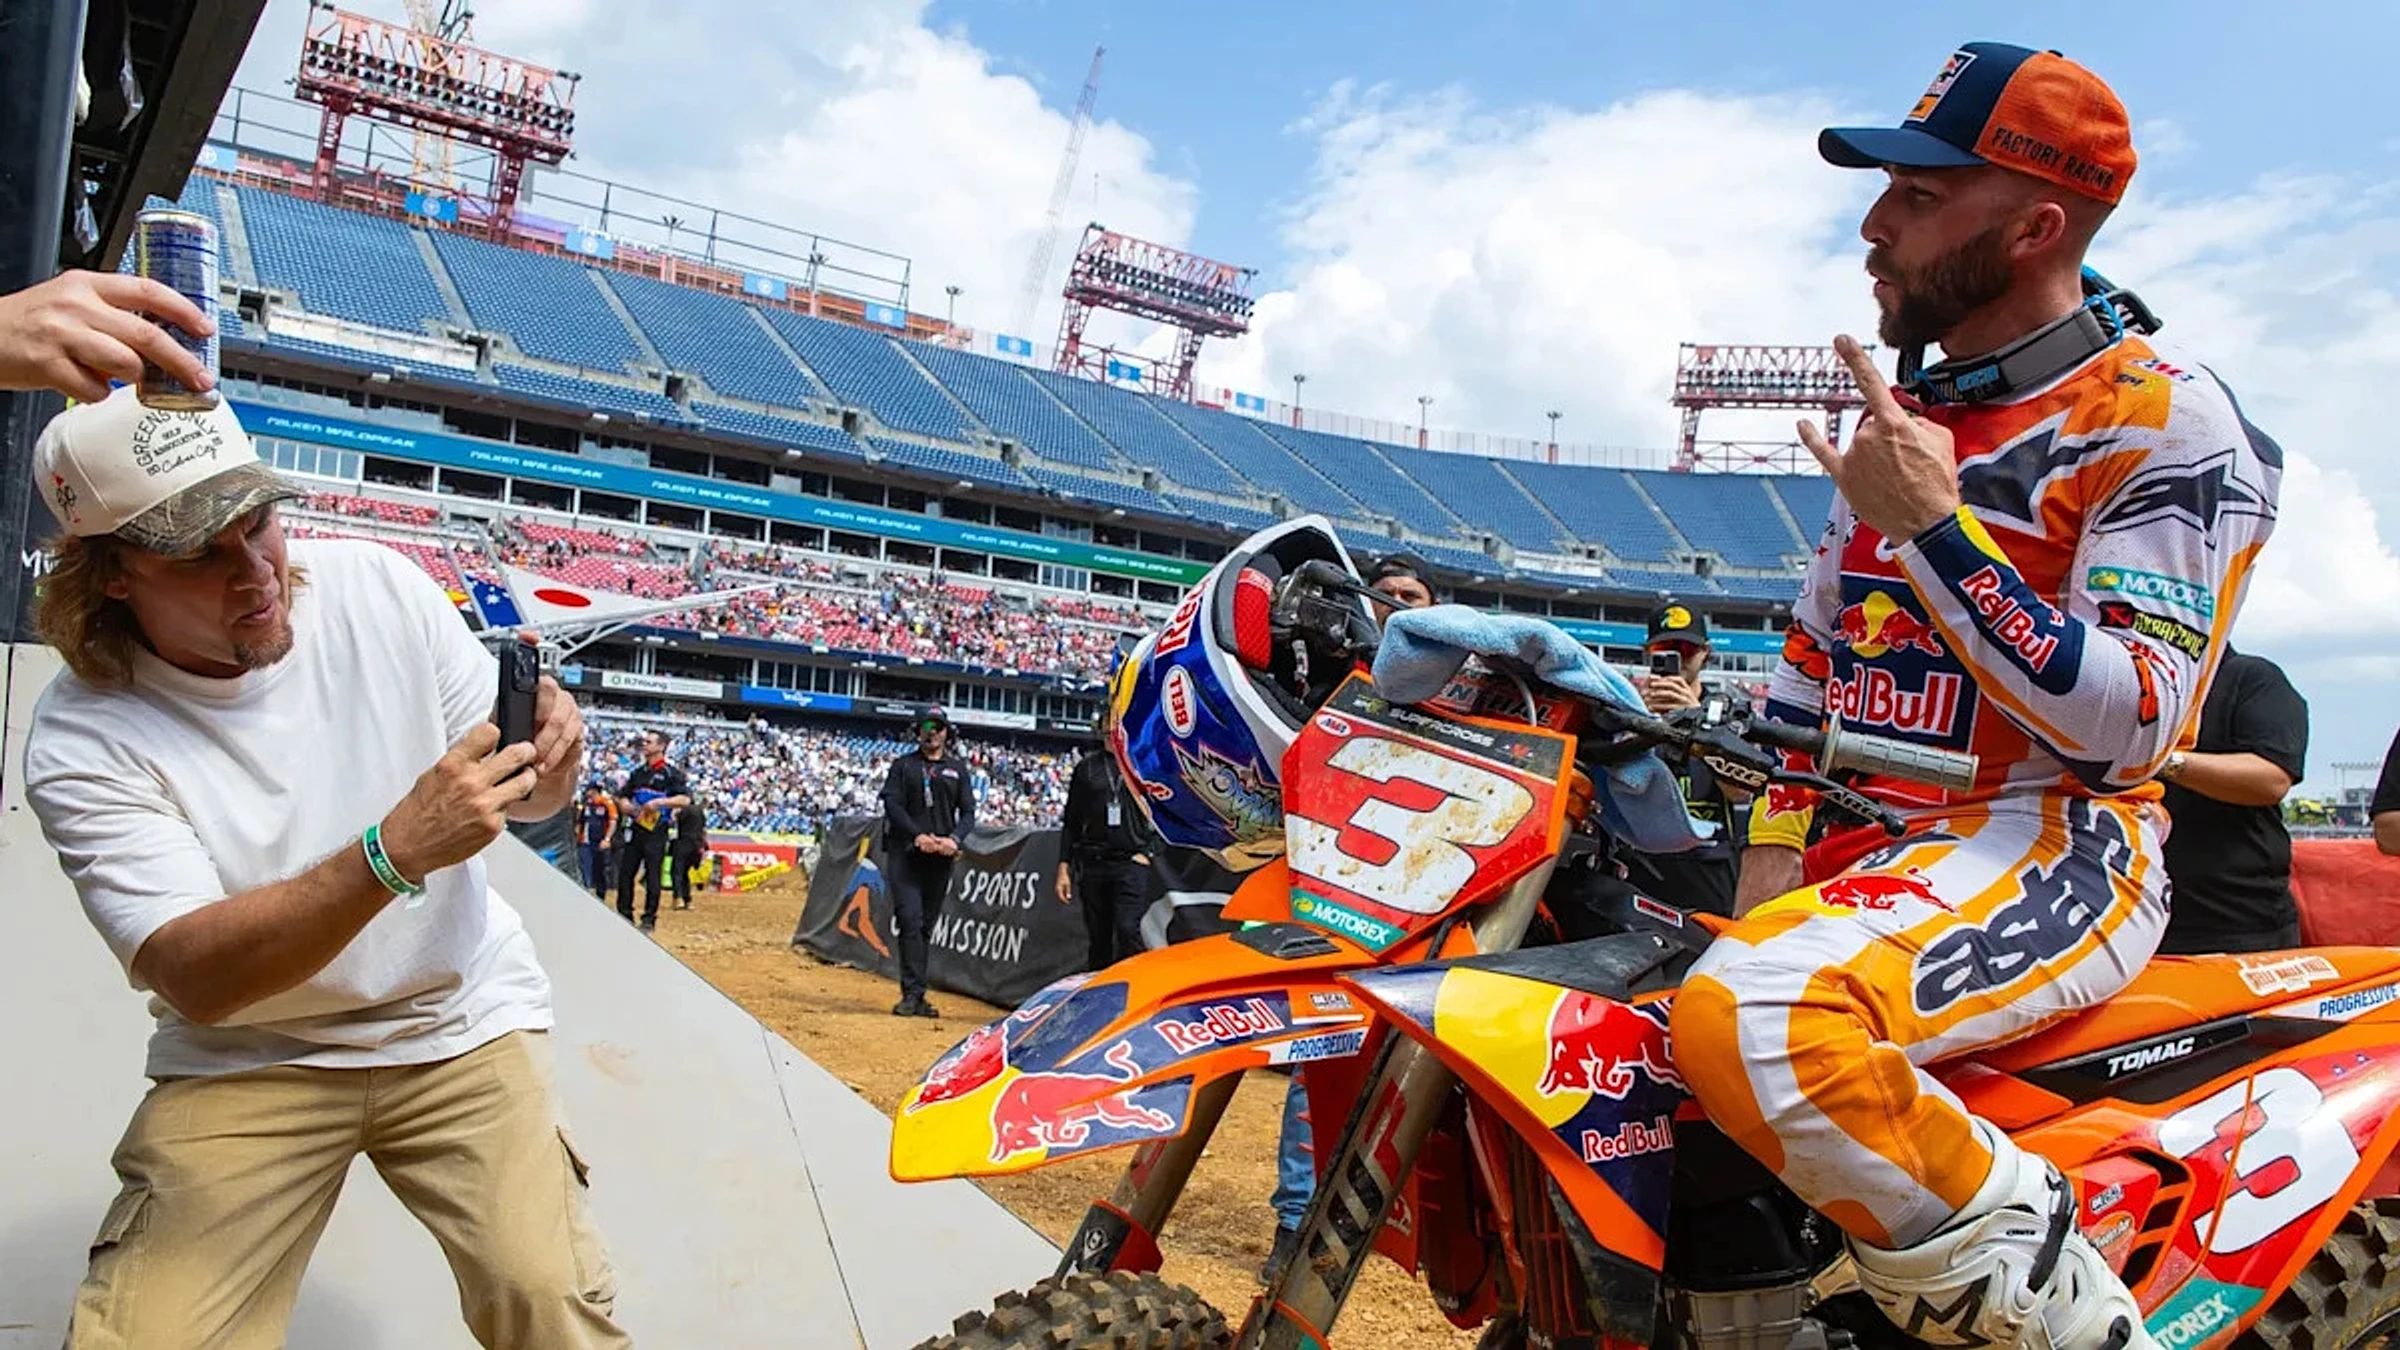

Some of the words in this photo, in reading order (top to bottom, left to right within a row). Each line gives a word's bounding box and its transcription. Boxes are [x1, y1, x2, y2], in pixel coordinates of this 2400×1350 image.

[1990, 126, 2062, 168] FACTORY
[2064, 153, 2115, 191] RACING
[132, 408, 171, 467] GREENS
[2120, 571, 2212, 614] MOTORE
[1169, 673, 1190, 728] BELL
[1827, 664, 1864, 722] ed
[1864, 669, 1962, 737] Bull
[1389, 706, 1496, 748] SUPERCROSS
[1283, 736, 1535, 916] 3
[706, 850, 778, 866] NDA
[958, 867, 1040, 910] SPORTS
[1312, 902, 1392, 945] MOTOREX
[2318, 984, 2399, 1018] PROGRESSIVE
[2106, 1036, 2196, 1078] TOMAC
[1582, 1122, 1632, 1162] Red
[1629, 1115, 1673, 1154] Bull
[2157, 1066, 2361, 1254] 3
[2151, 1290, 2235, 1350] TOREX
